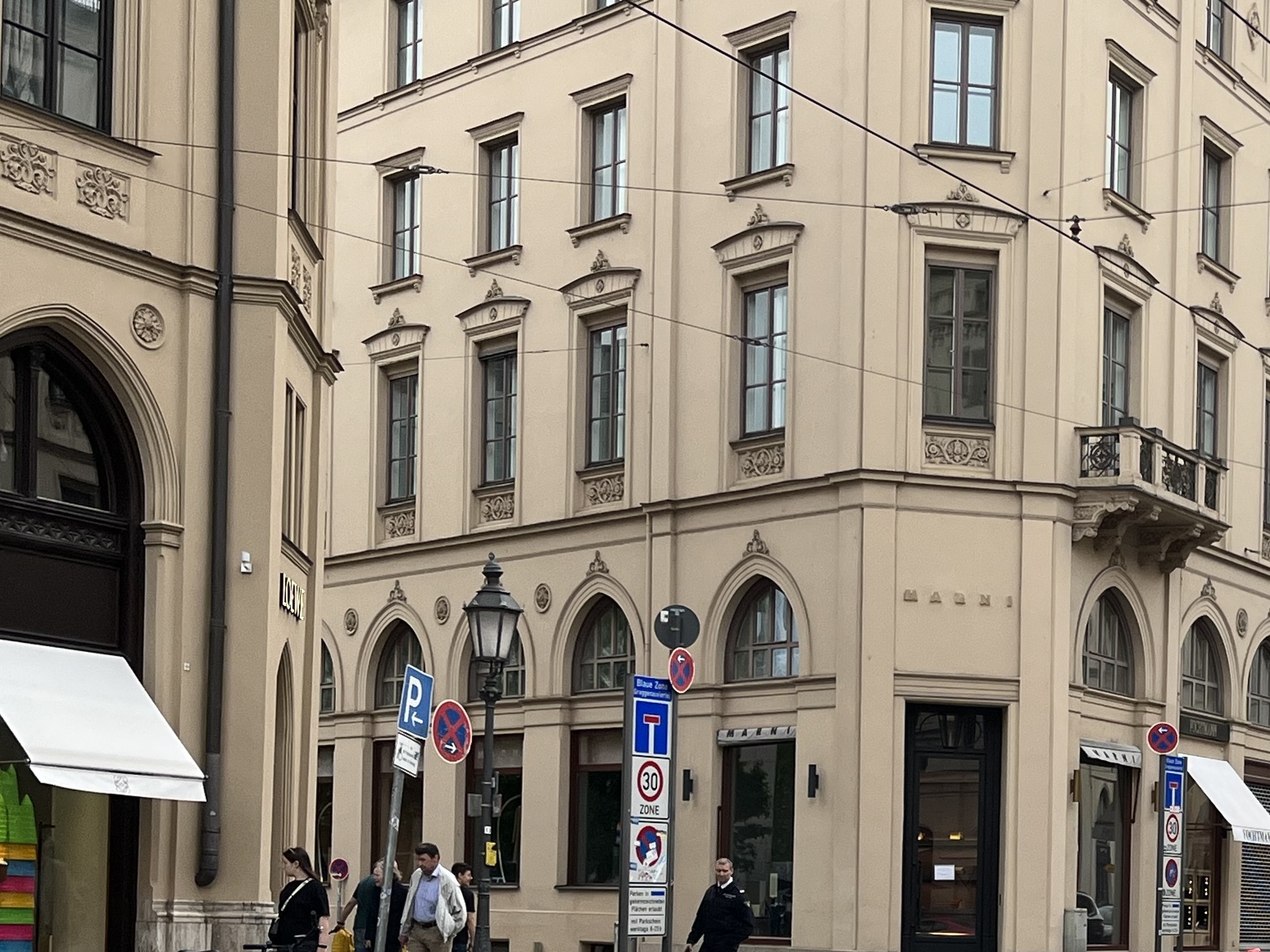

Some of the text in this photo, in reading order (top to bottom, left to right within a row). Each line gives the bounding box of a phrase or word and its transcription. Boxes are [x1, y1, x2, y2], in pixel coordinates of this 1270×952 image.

[281, 573, 305, 621] LOEWE
[903, 589, 1013, 608] MARNI
[636, 679, 668, 690] Blaue Zone
[404, 675, 423, 723] P
[726, 726, 791, 738] MARNI
[642, 771, 658, 791] 30
[639, 804, 660, 816] ZONE
[1169, 821, 1177, 835] 30
